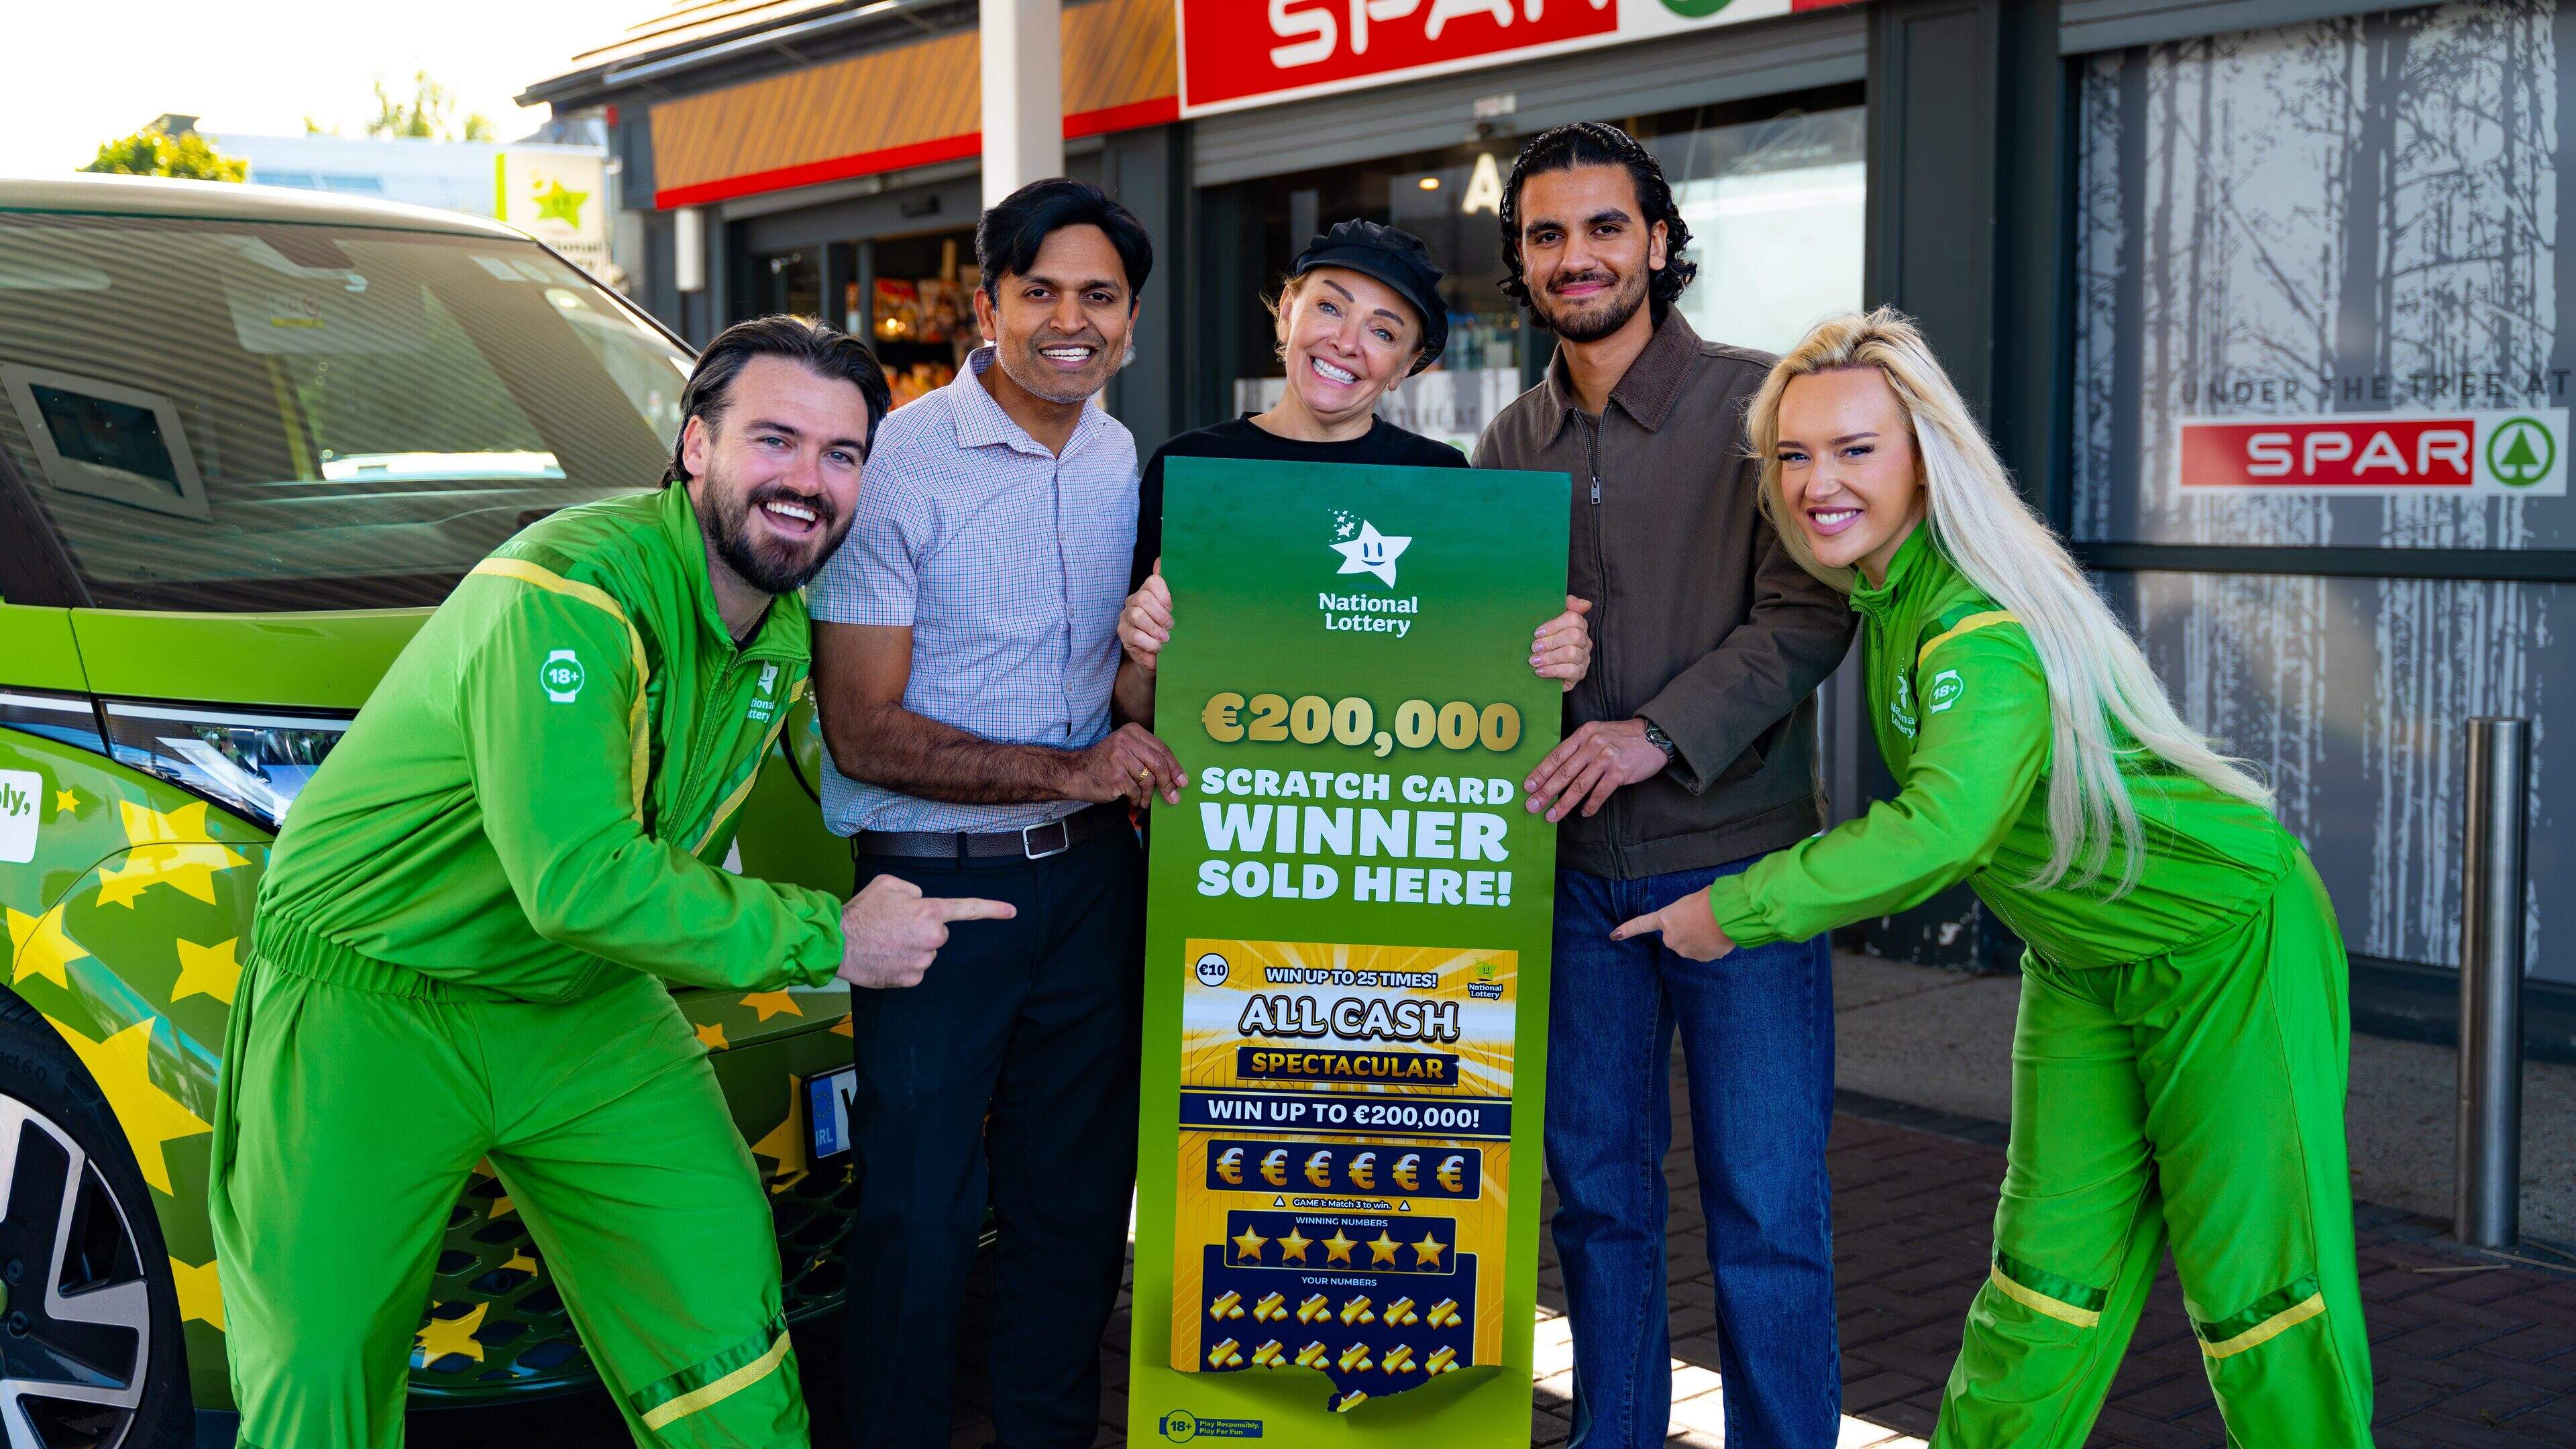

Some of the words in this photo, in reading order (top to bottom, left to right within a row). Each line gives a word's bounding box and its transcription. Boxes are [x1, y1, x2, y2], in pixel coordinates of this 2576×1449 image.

[1268, 0, 1607, 68] SP
[2181, 378, 2300, 404] UNDER
[2320, 375, 2389, 400] THE
[2409, 372, 2503, 398] TREE
[2524, 368, 2571, 396] AT
[2247, 430, 2469, 476] SPAR
[1319, 593, 1418, 614] National
[1325, 613, 1410, 638] Lottery
[549, 669, 579, 684] 18+
[1933, 685, 1958, 700] 18+
[751, 698, 775, 710] tional
[1201, 692, 1520, 757] €200,000
[1200, 767, 1390, 801] SCRATCH
[1401, 775, 1514, 805] CARD
[0, 783, 31, 816] ly,
[1199, 802, 1509, 863] WINNER
[1197, 859, 1339, 900] SOLD
[1354, 865, 1512, 907] HERE!
[1199, 964, 1226, 976] €10
[1265, 967, 1302, 983] WIN
[1305, 969, 1330, 984] UP
[1332, 970, 1355, 985] TO
[1357, 971, 1377, 986] 25
[1379, 972, 1438, 988] TIMES!
[1468, 983, 1503, 992] National
[1470, 990, 1500, 999] Lottery
[1239, 995, 1328, 1035] ALL
[1331, 998, 1460, 1042] CASH
[1252, 1052, 1444, 1079] SPECTACULAR
[1208, 1100, 1262, 1120] WIN
[1270, 1102, 1306, 1122] UP
[1312, 1104, 1347, 1124] TO
[1353, 1105, 1480, 1129] €200,000!
[815, 1127, 833, 1147] IRL
[1293, 1199, 1320, 1207] GAME
[1328, 1199, 1354, 1208] Match
[1373, 1201, 1391, 1210] win.
[1295, 1216, 1339, 1225] WINNING
[1341, 1218, 1388, 1227] NUMBERS
[1301, 1277, 1328, 1285] YOUR
[1330, 1278, 1377, 1287] NUMBERS
[1170, 1421, 1192, 1432] 18+
[1199, 1420, 1215, 1428] Play
[1216, 1421, 1260, 1430] Responsibly,
